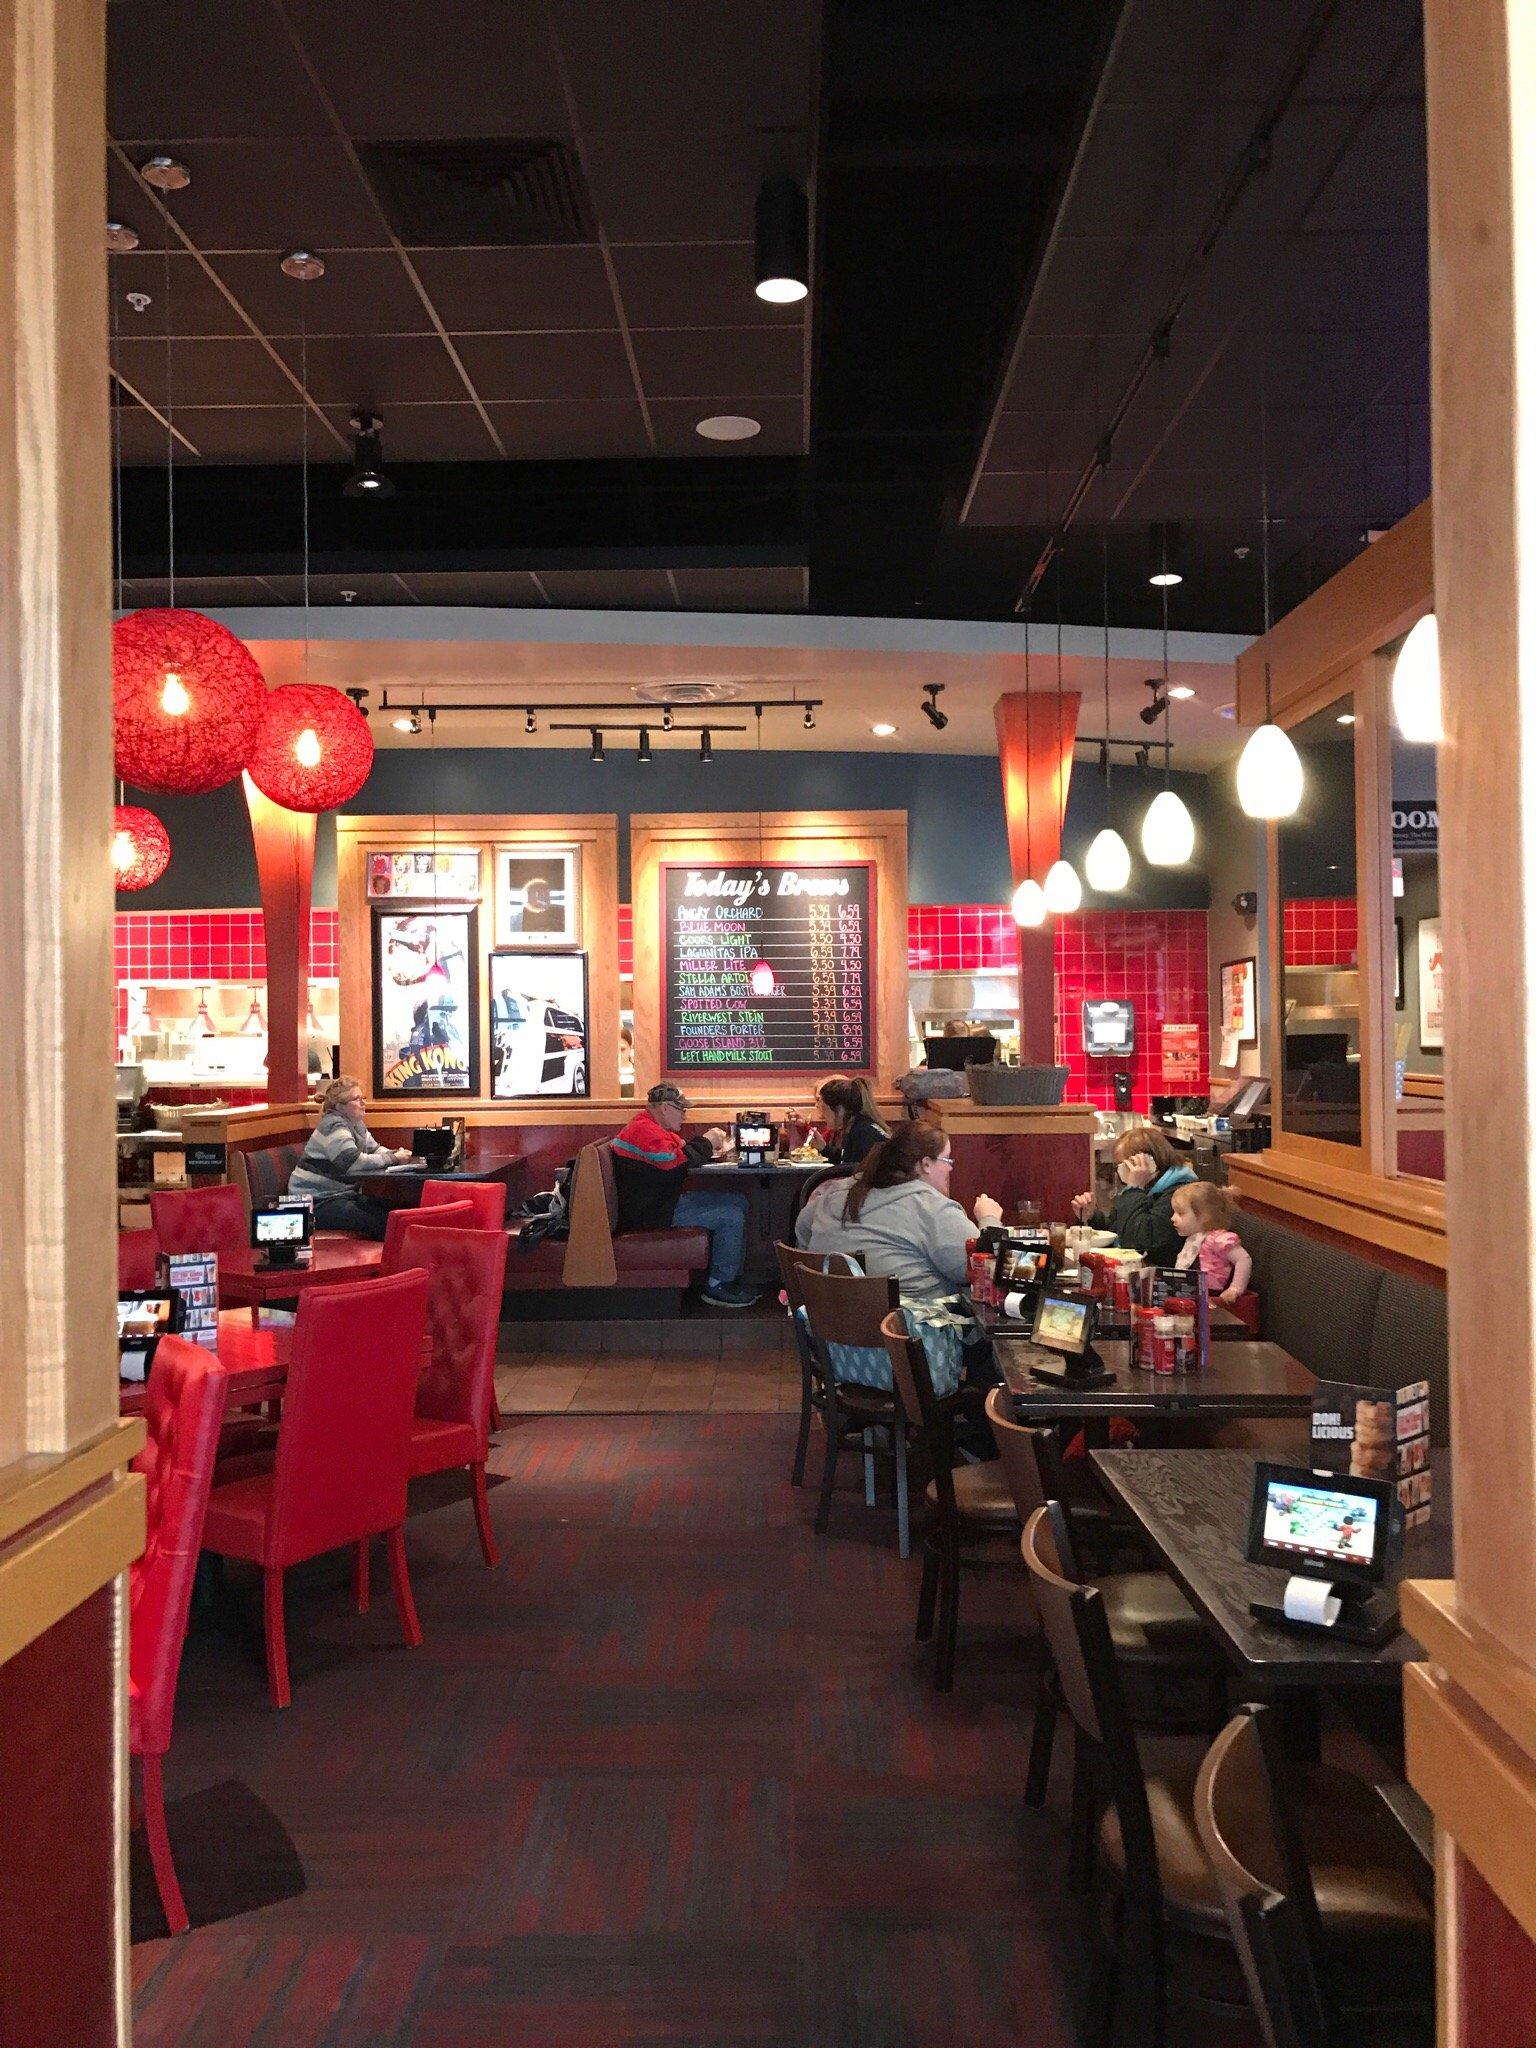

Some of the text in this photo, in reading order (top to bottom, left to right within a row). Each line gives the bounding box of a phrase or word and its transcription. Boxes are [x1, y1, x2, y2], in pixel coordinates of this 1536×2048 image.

[684, 870, 850, 906] Today's Brews
[715, 905, 763, 919] ORCHARD
[838, 904, 860, 919] 6.59
[680, 920, 860, 933] BLUE MOON 5.39 6.59
[679, 934, 714, 946] COORS
[810, 933, 833, 945] 3.50
[840, 933, 861, 945] 4.50
[810, 946, 833, 958] 6.59
[841, 946, 860, 958] 7.79
[724, 960, 746, 971] LITE
[811, 959, 834, 970] 3.50
[840, 959, 861, 970] 4.50
[679, 972, 717, 984] STELLA
[812, 972, 836, 984] 6.59
[841, 972, 861, 983] 7.79
[679, 985, 696, 997] SAM
[699, 985, 727, 997] ADAMS
[812, 984, 836, 996] 5.39
[842, 985, 861, 996] 6.59
[680, 999, 722, 1010] SPOTTED
[812, 998, 837, 1009] 5.39
[842, 998, 862, 1009] 6.59
[812, 1010, 837, 1022] 5.39
[843, 1011, 862, 1022] 6.59
[680, 1024, 863, 1036] FOUNDERS PORTER 7.99 8.99
[679, 1038, 710, 1050] GOOSE
[749, 1037, 767, 1048] 312
[814, 1037, 839, 1048] 5.39
[843, 1037, 863, 1048] 6.59
[680, 1050, 699, 1061] LEFT
[702, 1050, 725, 1061] HAND
[749, 1049, 773, 1061] STOUT
[841, 1050, 861, 1061] 6.59
[385, 1055, 423, 1088] KING
